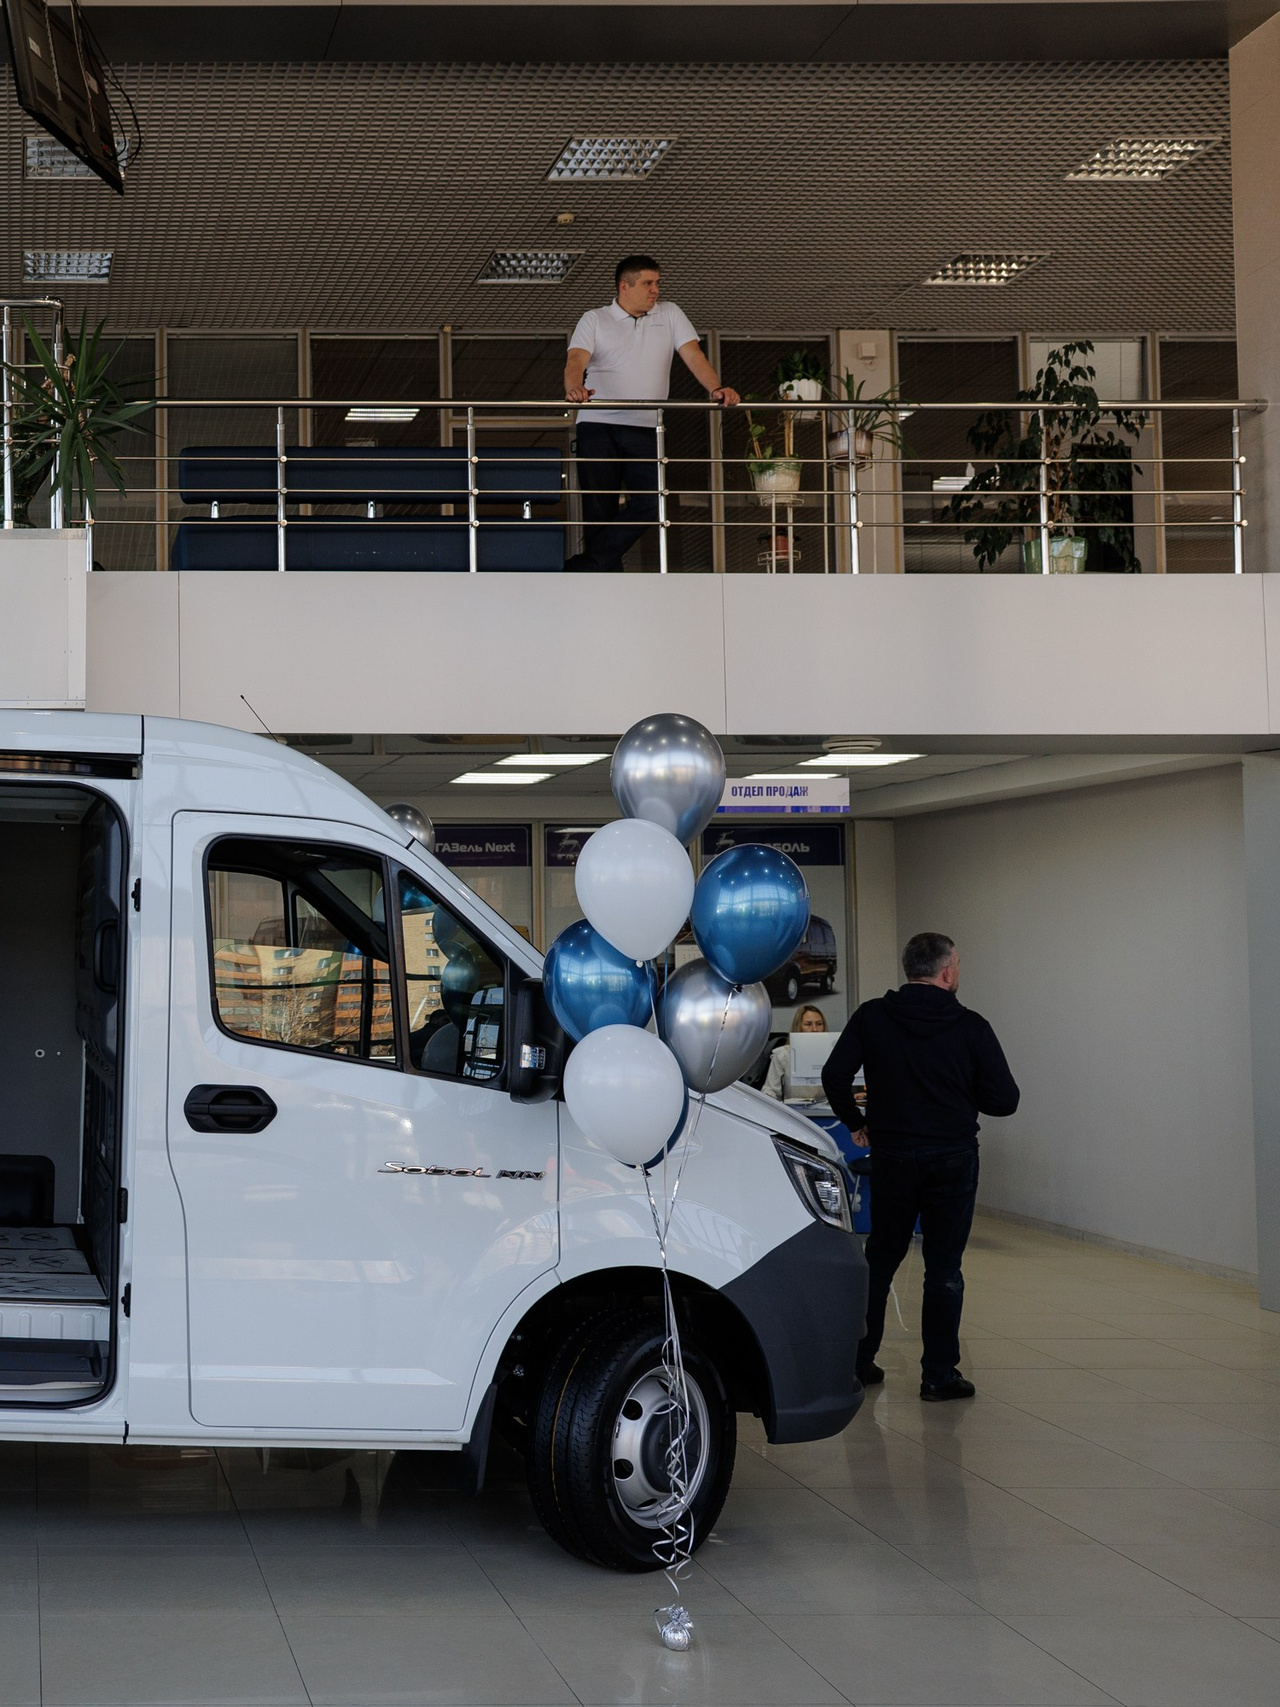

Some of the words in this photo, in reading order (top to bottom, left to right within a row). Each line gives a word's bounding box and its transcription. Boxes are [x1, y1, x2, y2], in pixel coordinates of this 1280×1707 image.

[731, 786, 763, 798] ОТДЕЛ
[766, 786, 808, 798] ПРОДАЖ
[435, 842, 482, 853] ГАЗель
[485, 842, 516, 853] Next
[765, 842, 810, 853] БОЛЬ
[495, 1169, 547, 1180] NN
